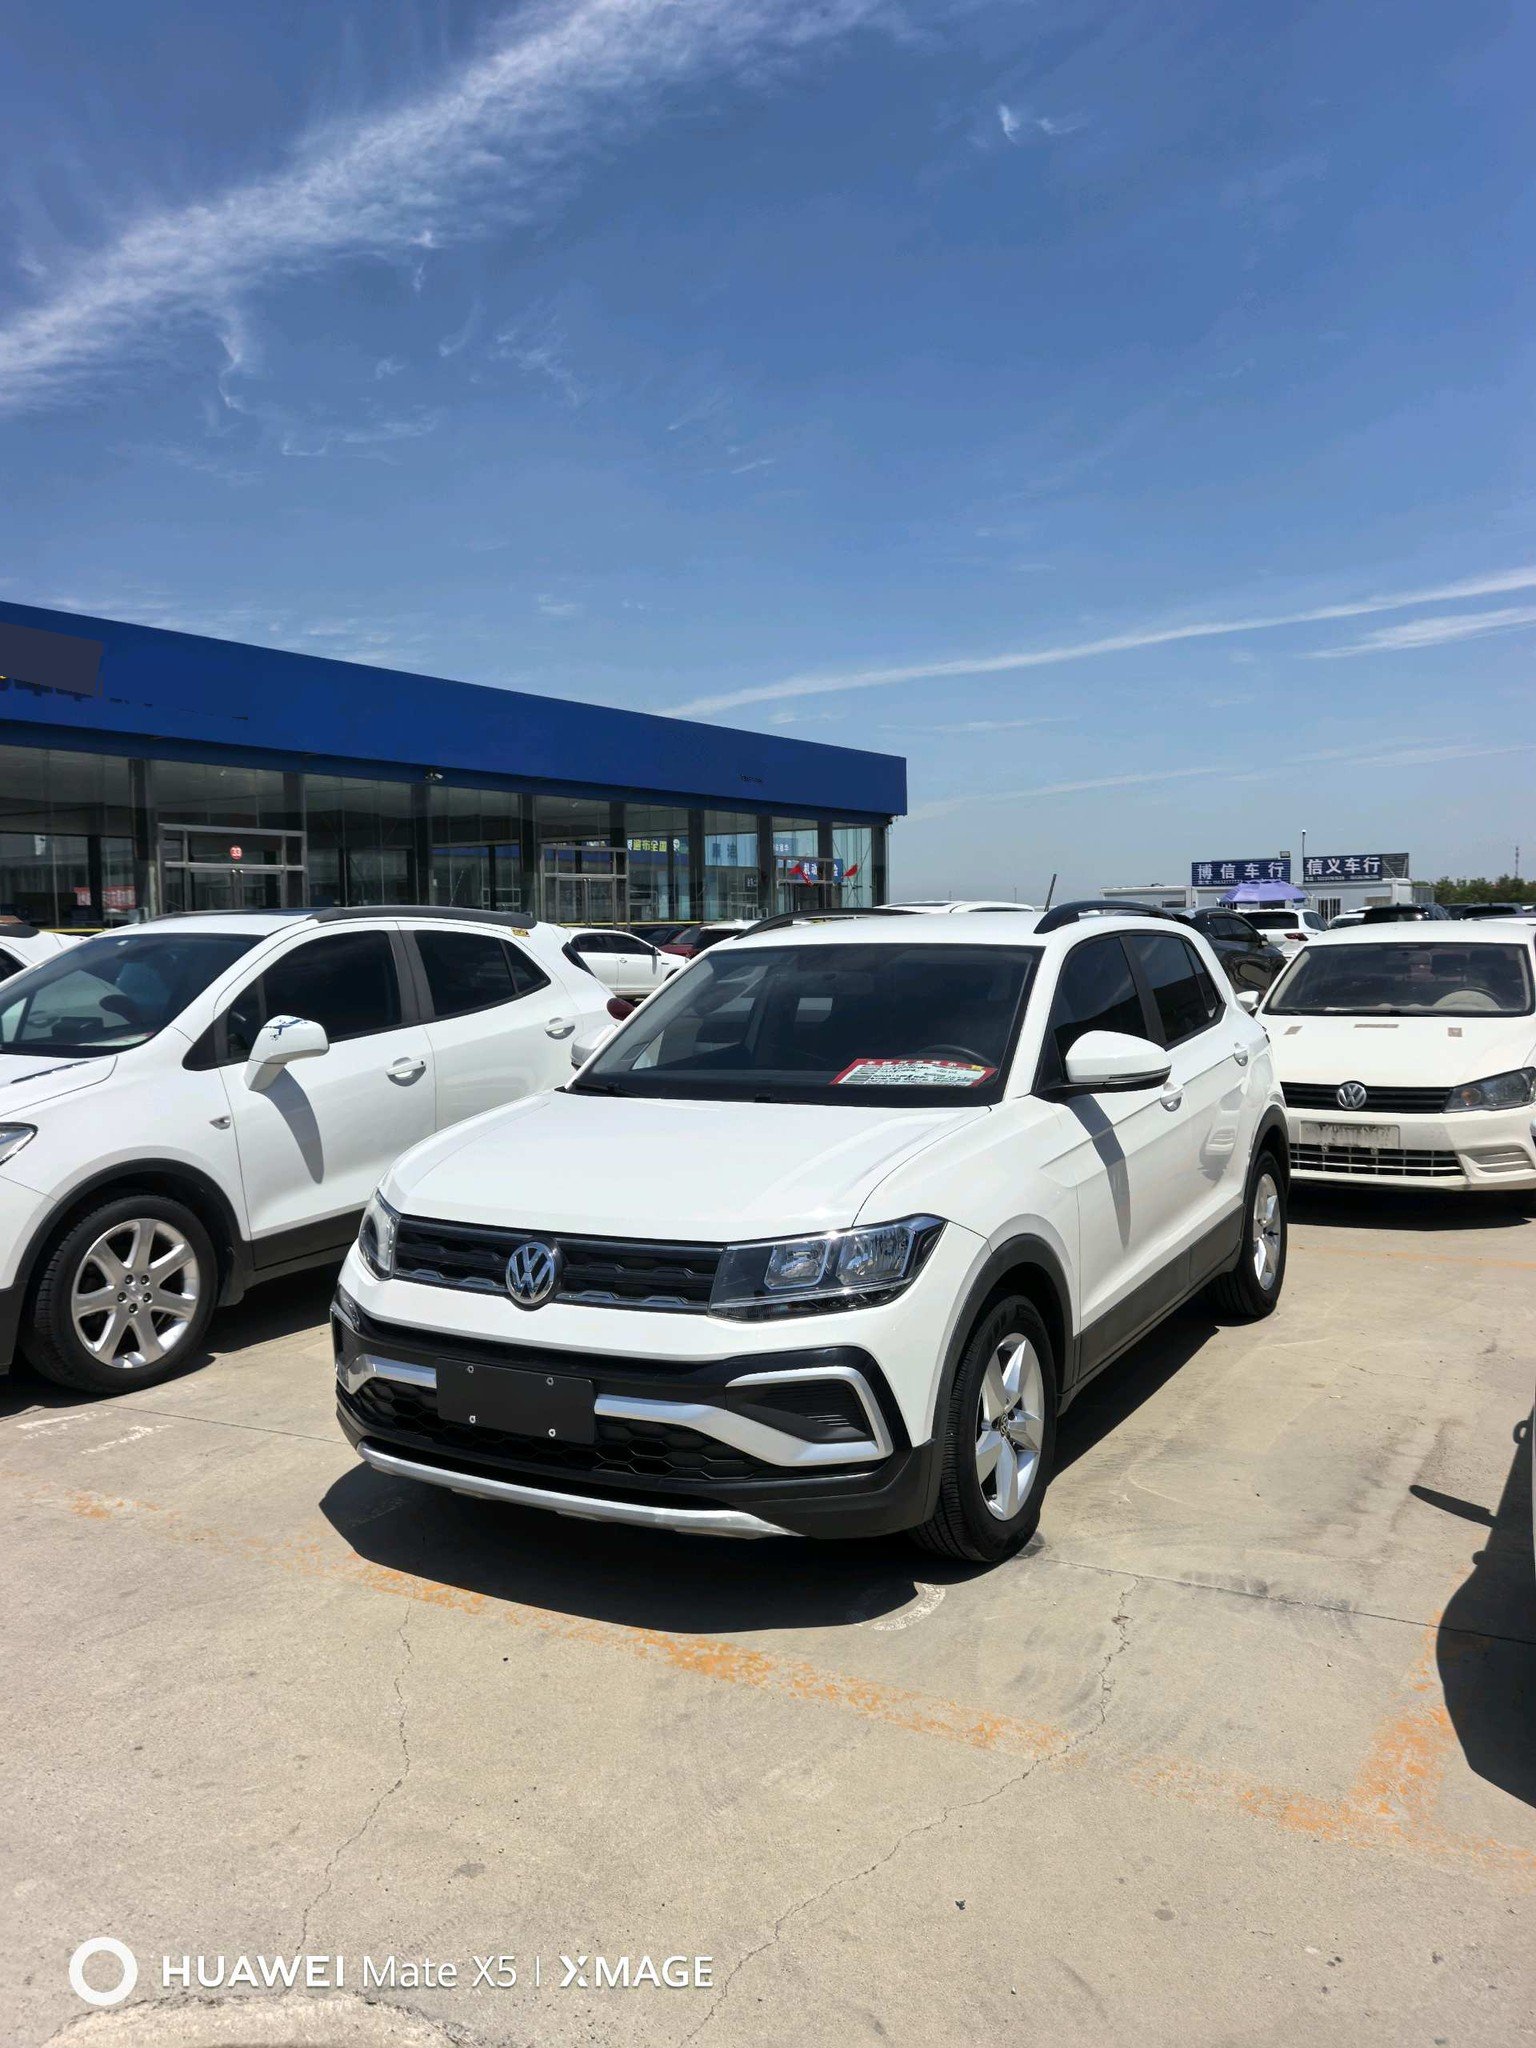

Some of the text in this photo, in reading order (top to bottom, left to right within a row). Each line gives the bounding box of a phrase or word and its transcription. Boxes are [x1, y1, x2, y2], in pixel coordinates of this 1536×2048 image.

[1197, 862, 1284, 879] 博信车行
[1306, 857, 1380, 875] 信义车行
